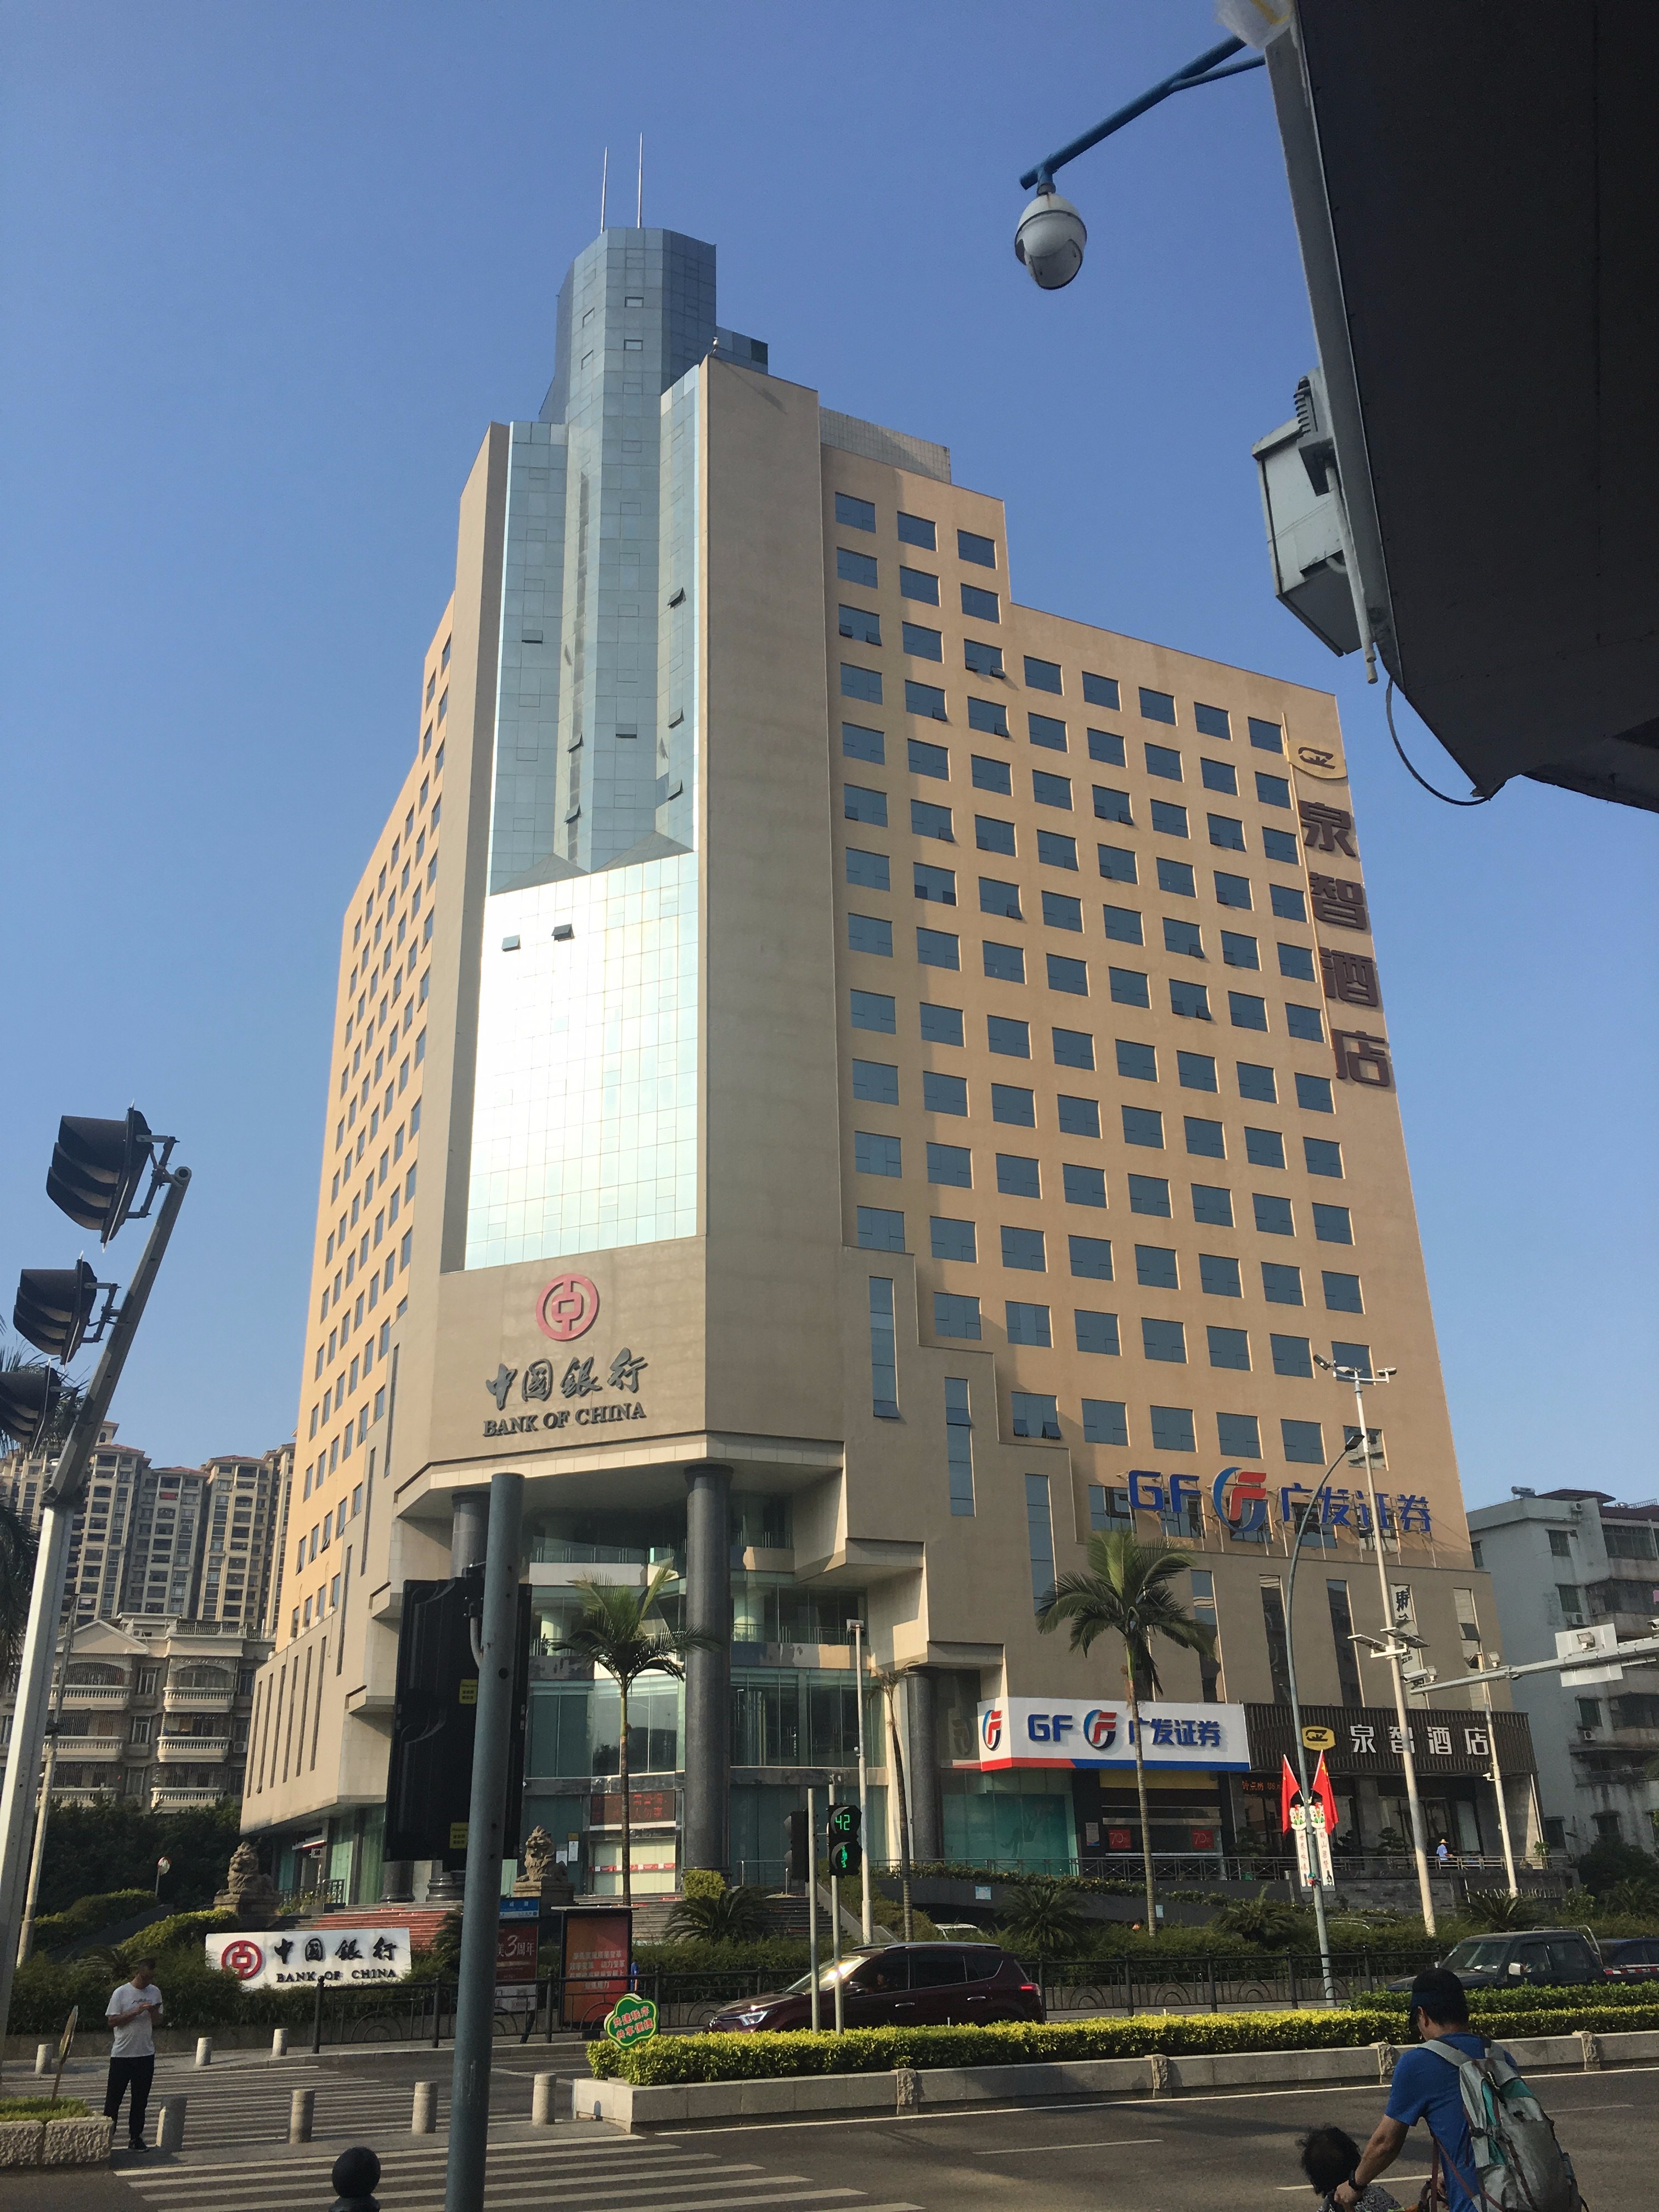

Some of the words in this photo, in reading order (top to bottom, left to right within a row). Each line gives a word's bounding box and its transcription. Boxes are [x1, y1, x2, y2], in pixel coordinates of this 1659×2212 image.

[1298, 799, 1391, 1087] 泉智酒店
[483, 1415, 538, 1437] BANK
[543, 1410, 569, 1429] OF
[575, 1402, 647, 1425] CHINA
[1127, 1470, 1200, 1512] GF
[1278, 1483, 1431, 1532] 广发证券
[1028, 1714, 1073, 1742] GF
[1128, 1717, 1221, 1747] 广发证券
[1350, 1724, 1489, 1756] 泉智酒店
[835, 1815, 850, 1830] 42
[276, 1971, 315, 1983] BANK
[324, 1971, 341, 1980] OF
[351, 1969, 397, 1979] CHINA
